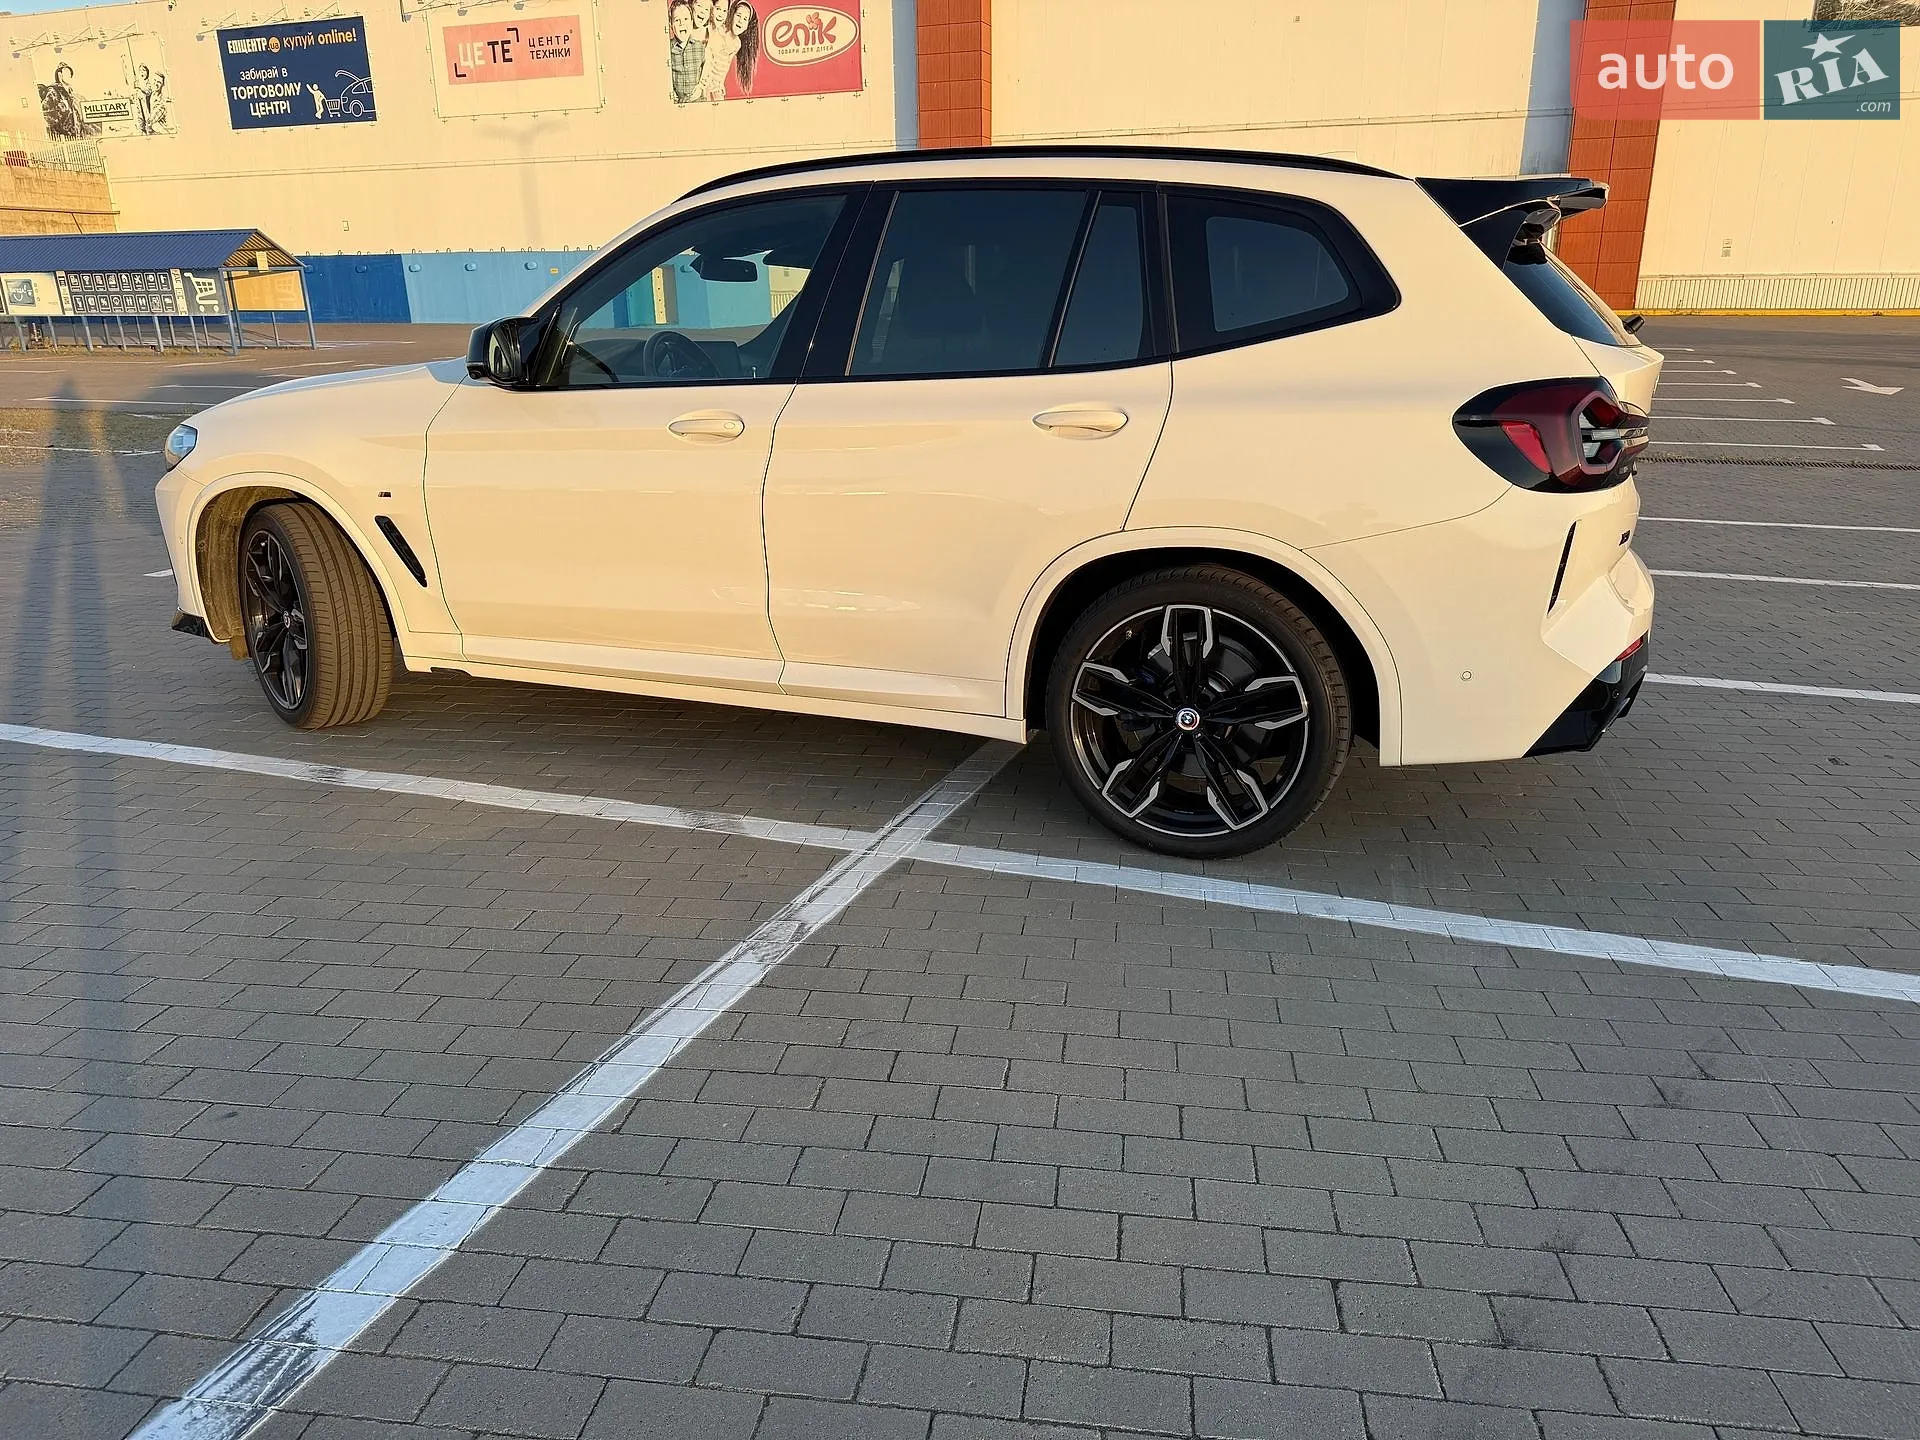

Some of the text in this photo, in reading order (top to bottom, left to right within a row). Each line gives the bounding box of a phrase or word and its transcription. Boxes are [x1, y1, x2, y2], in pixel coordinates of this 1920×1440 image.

[283, 32, 315, 51] купуй
[317, 27, 358, 45] online!
[528, 35, 570, 48] ЦЕНТР
[529, 48, 571, 60] ТЕХНІКИ
[240, 66, 288, 82] забирай в
[231, 82, 301, 100] ТОРГОВОМУ
[84, 103, 127, 112] MILITARY
[249, 101, 291, 118] ЦЕНТРІ
